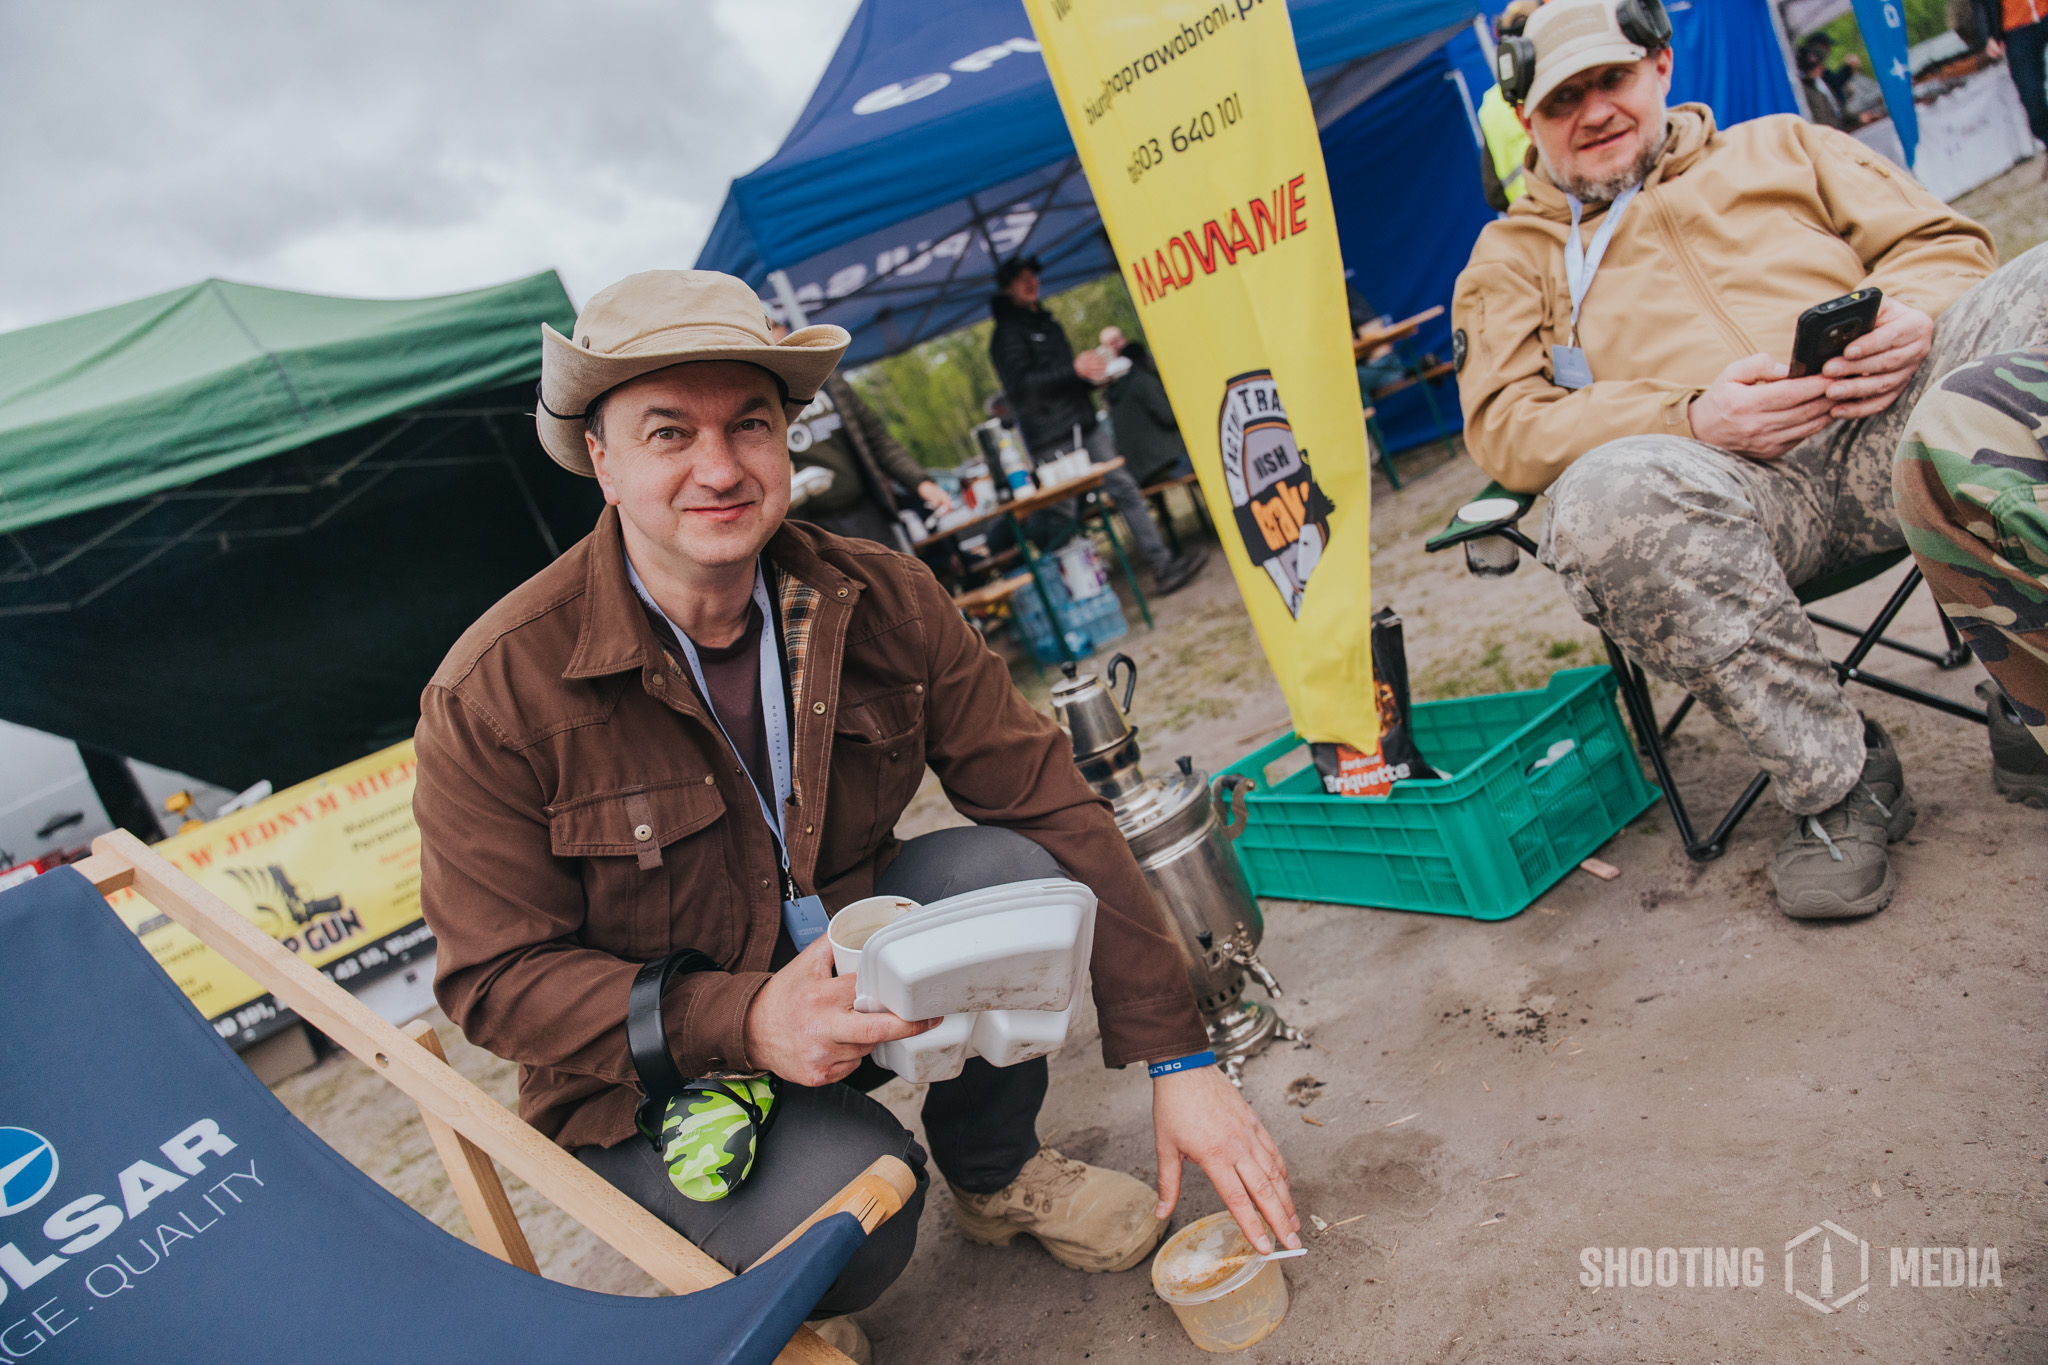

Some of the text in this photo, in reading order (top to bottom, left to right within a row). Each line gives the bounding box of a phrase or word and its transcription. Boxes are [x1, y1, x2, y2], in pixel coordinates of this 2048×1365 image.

[1171, 110, 1216, 153] 640
[1217, 92, 1243, 129] 101
[1238, 388, 1284, 415] TRA
[226, 794, 340, 855] JEDNYM
[343, 758, 420, 800] MIEJ
[304, 908, 364, 952] GUN
[0, 1118, 238, 1305] LSAR
[0, 1296, 79, 1365] GE
